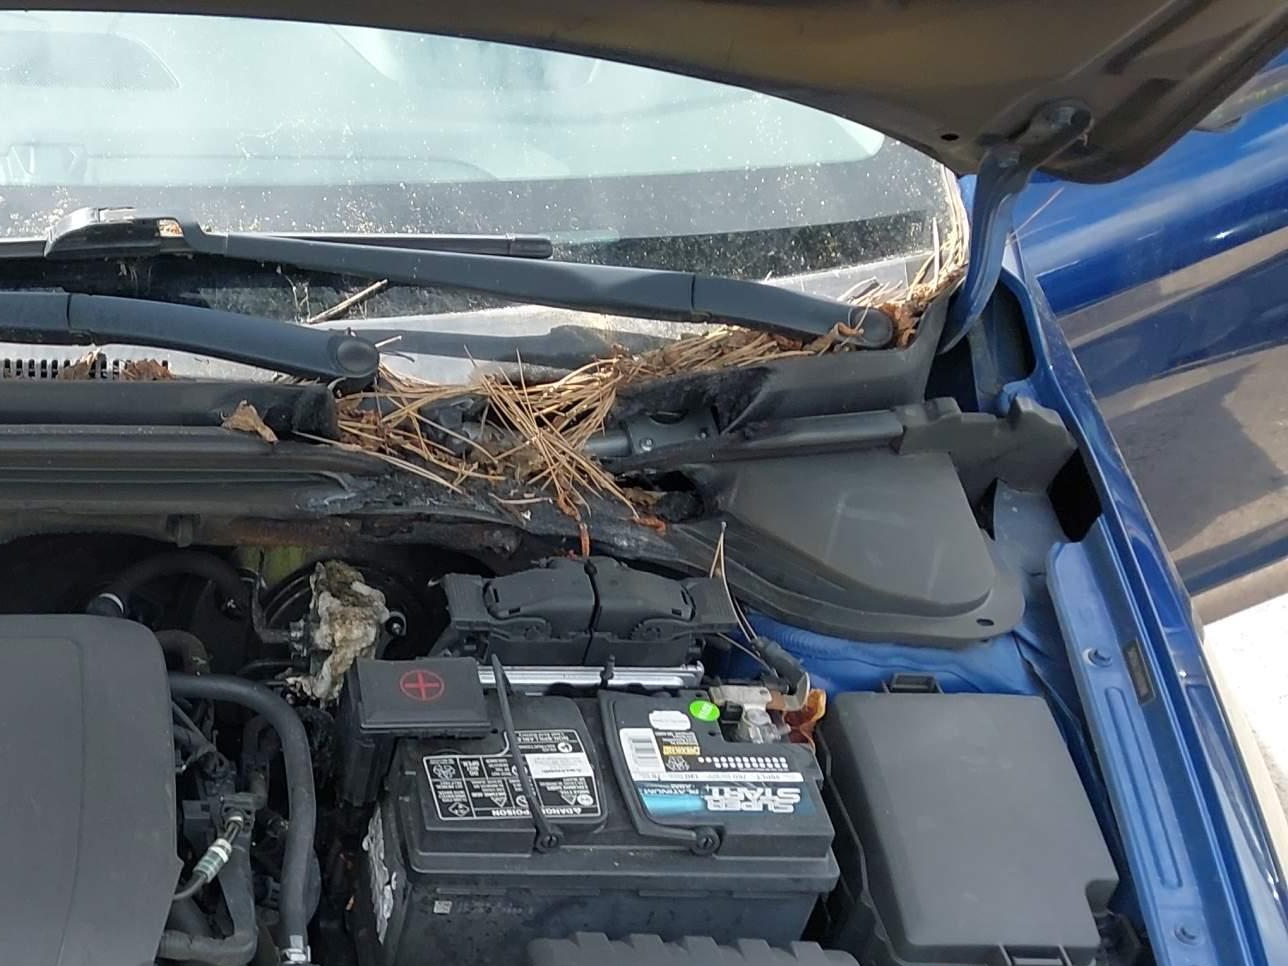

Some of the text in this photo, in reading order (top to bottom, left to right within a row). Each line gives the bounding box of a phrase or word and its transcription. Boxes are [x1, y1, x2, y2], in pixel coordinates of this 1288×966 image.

[702, 786, 801, 803] START
[491, 808, 530, 817] POISON
[707, 798, 794, 813] SUPER
